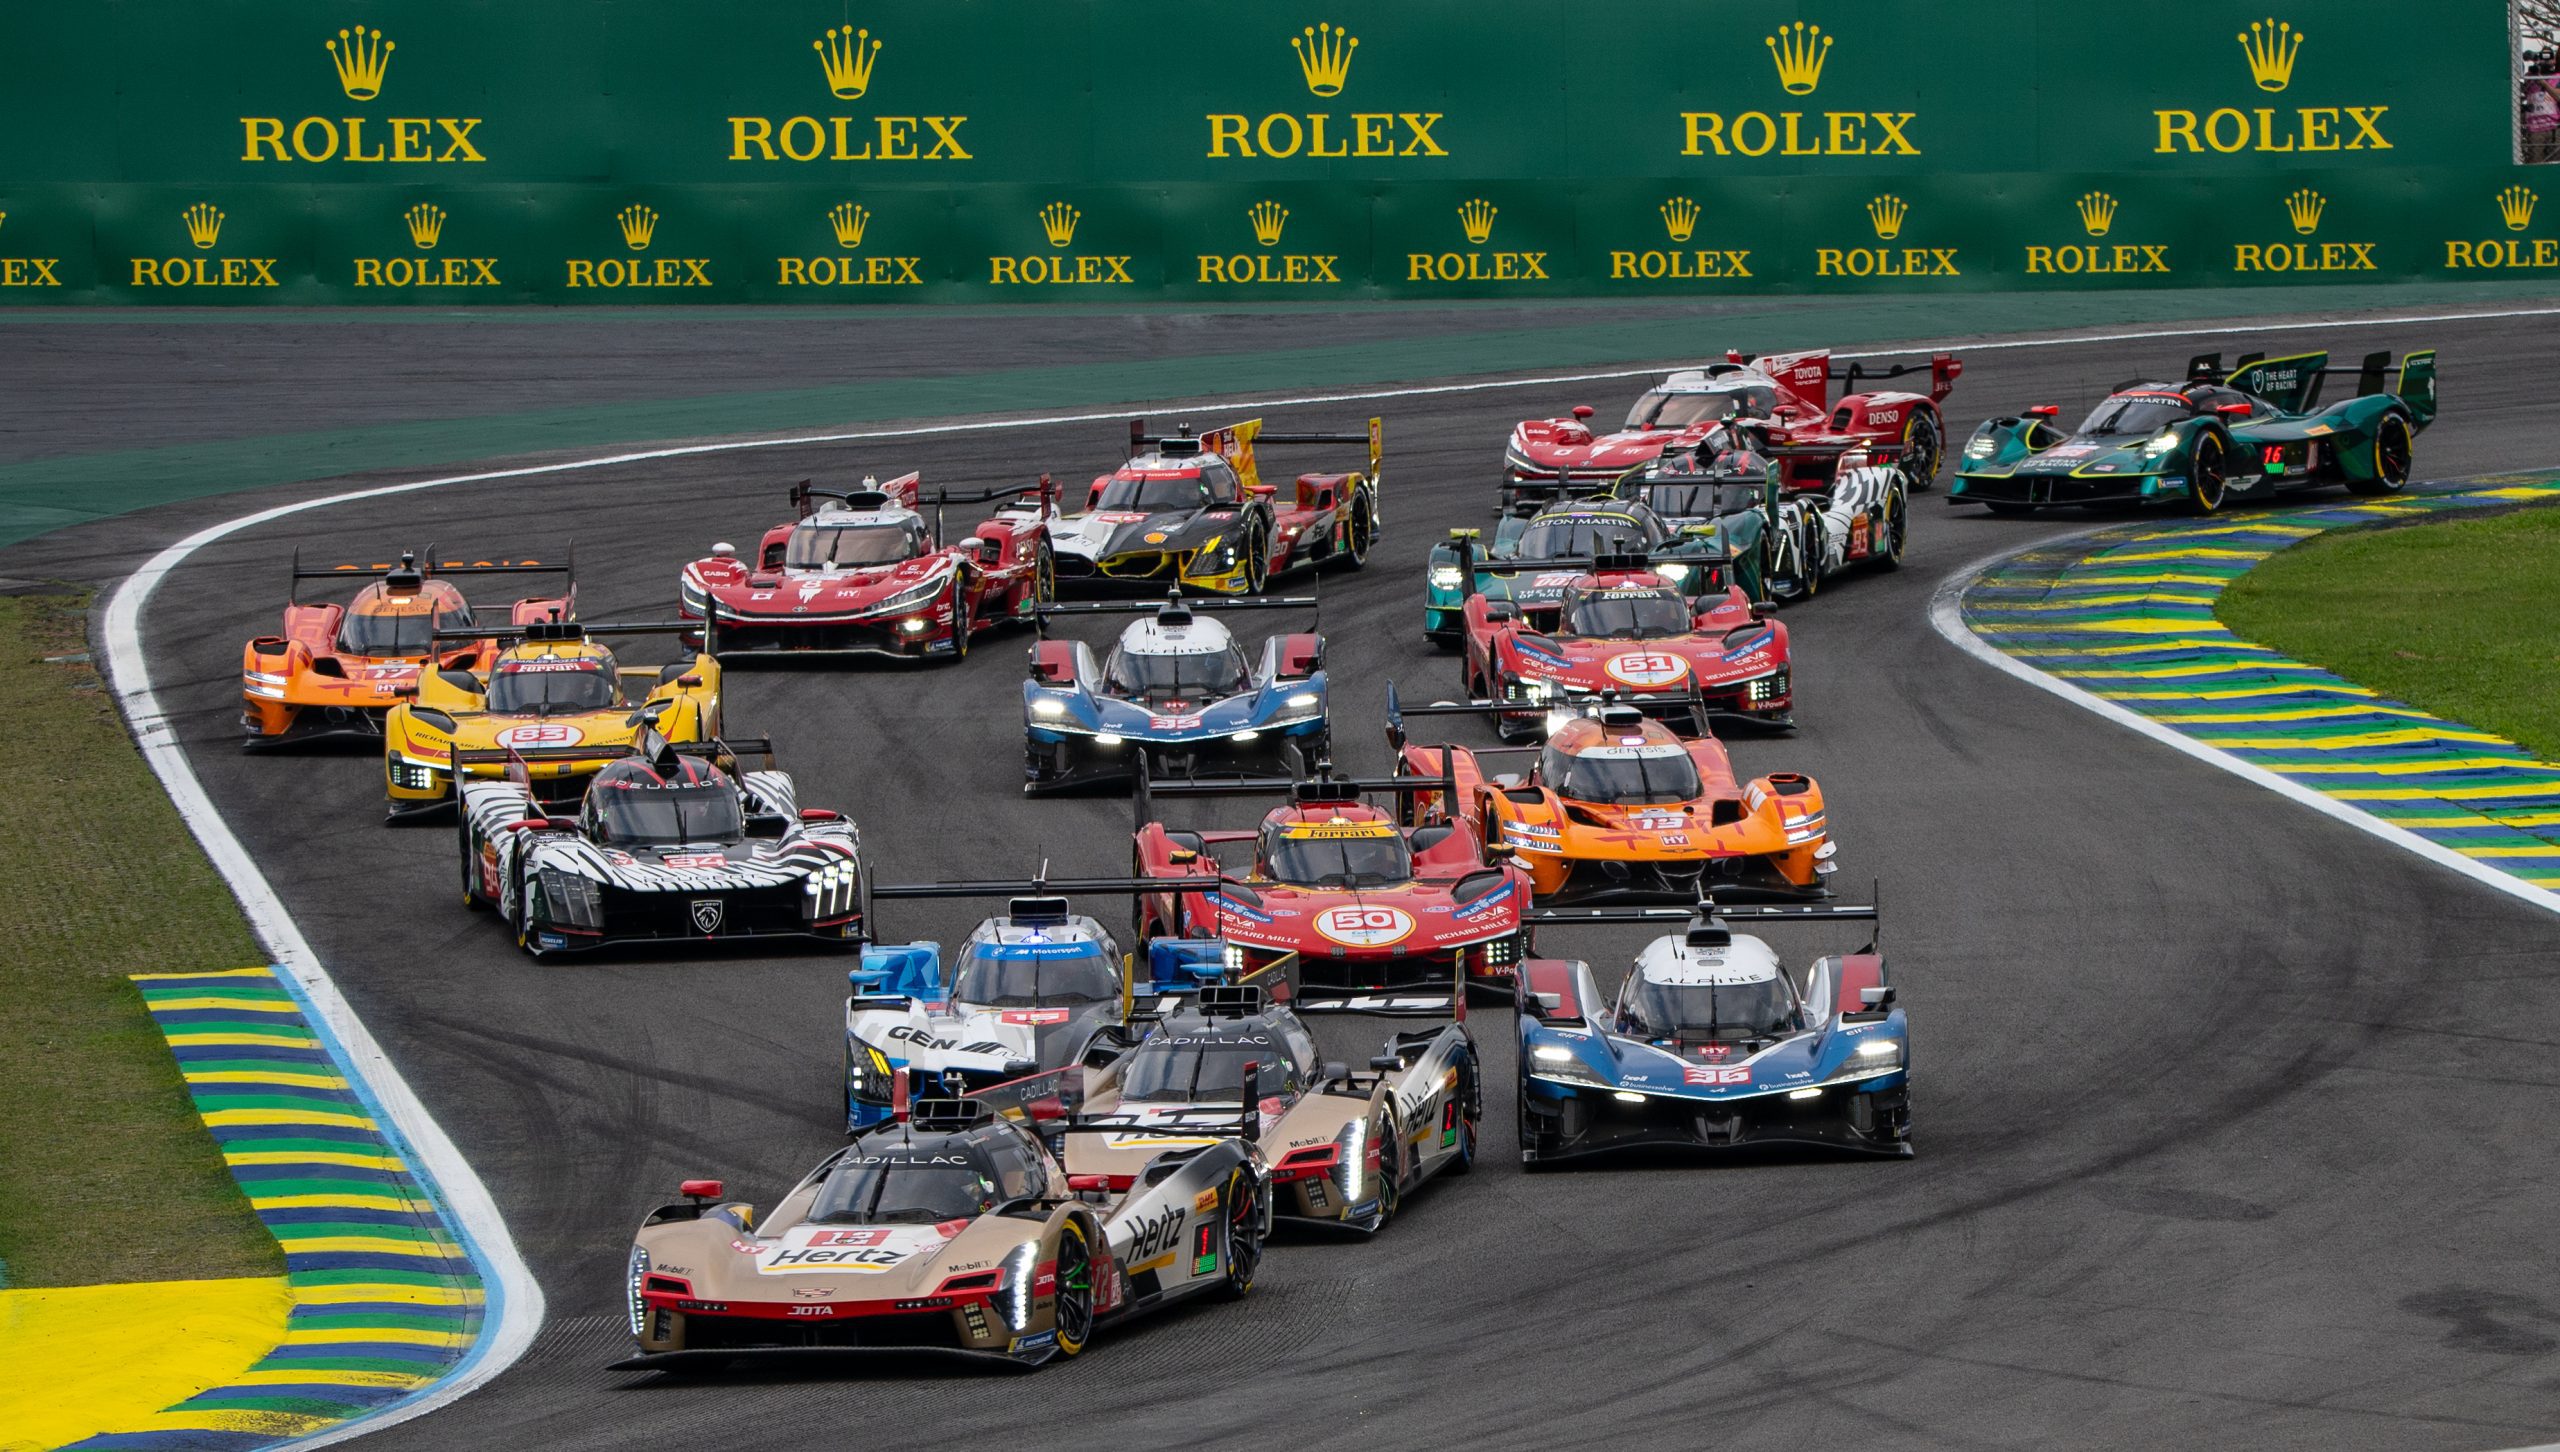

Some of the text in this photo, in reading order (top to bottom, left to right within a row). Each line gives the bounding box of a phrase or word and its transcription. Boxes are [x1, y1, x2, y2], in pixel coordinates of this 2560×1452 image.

[1207, 113, 1448, 158] ROLEX
[1681, 111, 1920, 156] ROLEX
[2155, 106, 2393, 152] ROLEX
[240, 117, 486, 162] ROLEX
[728, 116, 973, 161] ROLEX
[2027, 245, 2169, 272] ROLEX
[2235, 244, 2376, 271] ROLEX
[2447, 240, 2558, 267] ROLE
[991, 256, 1132, 284] ROLEX
[1199, 255, 1339, 283] ROLEX
[1408, 253, 1548, 280] ROLEX
[1612, 251, 1751, 278] ROLEX
[1817, 249, 1960, 276] ROLEX
[131, 258, 277, 286] ROLEX
[355, 258, 500, 286] ROLEX
[567, 259, 711, 287] ROLEX
[779, 257, 922, 285] ROLEX
[1794, 366, 1822, 379] TOYOTA
[2266, 369, 2297, 382] THE HEART
[2266, 379, 2297, 392] OF RACING
[2132, 398, 2182, 407] MARTIN
[1869, 410, 1899, 425] DENSO
[2264, 447, 2284, 463] 16
[1533, 517, 1633, 529] ASTON MARTIN
[703, 570, 730, 578] CASIO
[836, 589, 859, 598] HY
[1601, 590, 1662, 600] Ferrari
[517, 663, 581, 673] Ferrari
[1622, 654, 1671, 672] 51
[1704, 661, 1771, 681] RICHARD MILLE
[1564, 676, 1595, 686] MILLE
[1165, 701, 1189, 709] HY
[1757, 699, 1786, 710] V-Power
[1152, 717, 1201, 729] 35
[514, 728, 566, 741] 83
[1606, 745, 1667, 755] GENESIS
[615, 777, 722, 790] PEUGEOT
[1640, 818, 1684, 830] 19
[1308, 828, 1377, 839] Ferrari
[1662, 835, 1690, 846] HY
[668, 857, 726, 869] 94
[1206, 895, 1235, 911] ADLER
[1242, 910, 1272, 924] GROUP
[1456, 905, 1481, 919] ADLER
[1487, 889, 1512, 905] GROUP
[1334, 911, 1394, 928] 50
[1220, 926, 1265, 940] RICHARD
[1266, 935, 1301, 945] MILLE
[1433, 918, 1511, 942] RICHARD MILLE
[1032, 946, 1083, 955] Motorsport
[1266, 966, 1288, 986] CADILLAC
[1661, 973, 1764, 984] ALPINE
[887, 1026, 958, 1051] GEN
[1148, 1035, 1270, 1047] CADILLAC
[1700, 1046, 1728, 1055] HY
[1686, 1068, 1750, 1084] 36
[1019, 1079, 1058, 1101] CADILLAC
[1629, 1081, 1676, 1093] businessolver
[1289, 1138, 1319, 1149] Mobil
[838, 1155, 968, 1166] CADILLAC
[821, 1231, 876, 1245] 12
[1125, 1203, 1186, 1265] Hertz
[1201, 1225, 1210, 1257] 1
[732, 1240, 765, 1254] HY
[767, 1248, 909, 1267] Hertz
[656, 1263, 684, 1274] Mobil
[948, 1261, 981, 1273] Mobil
[787, 1305, 834, 1316] JOTA
